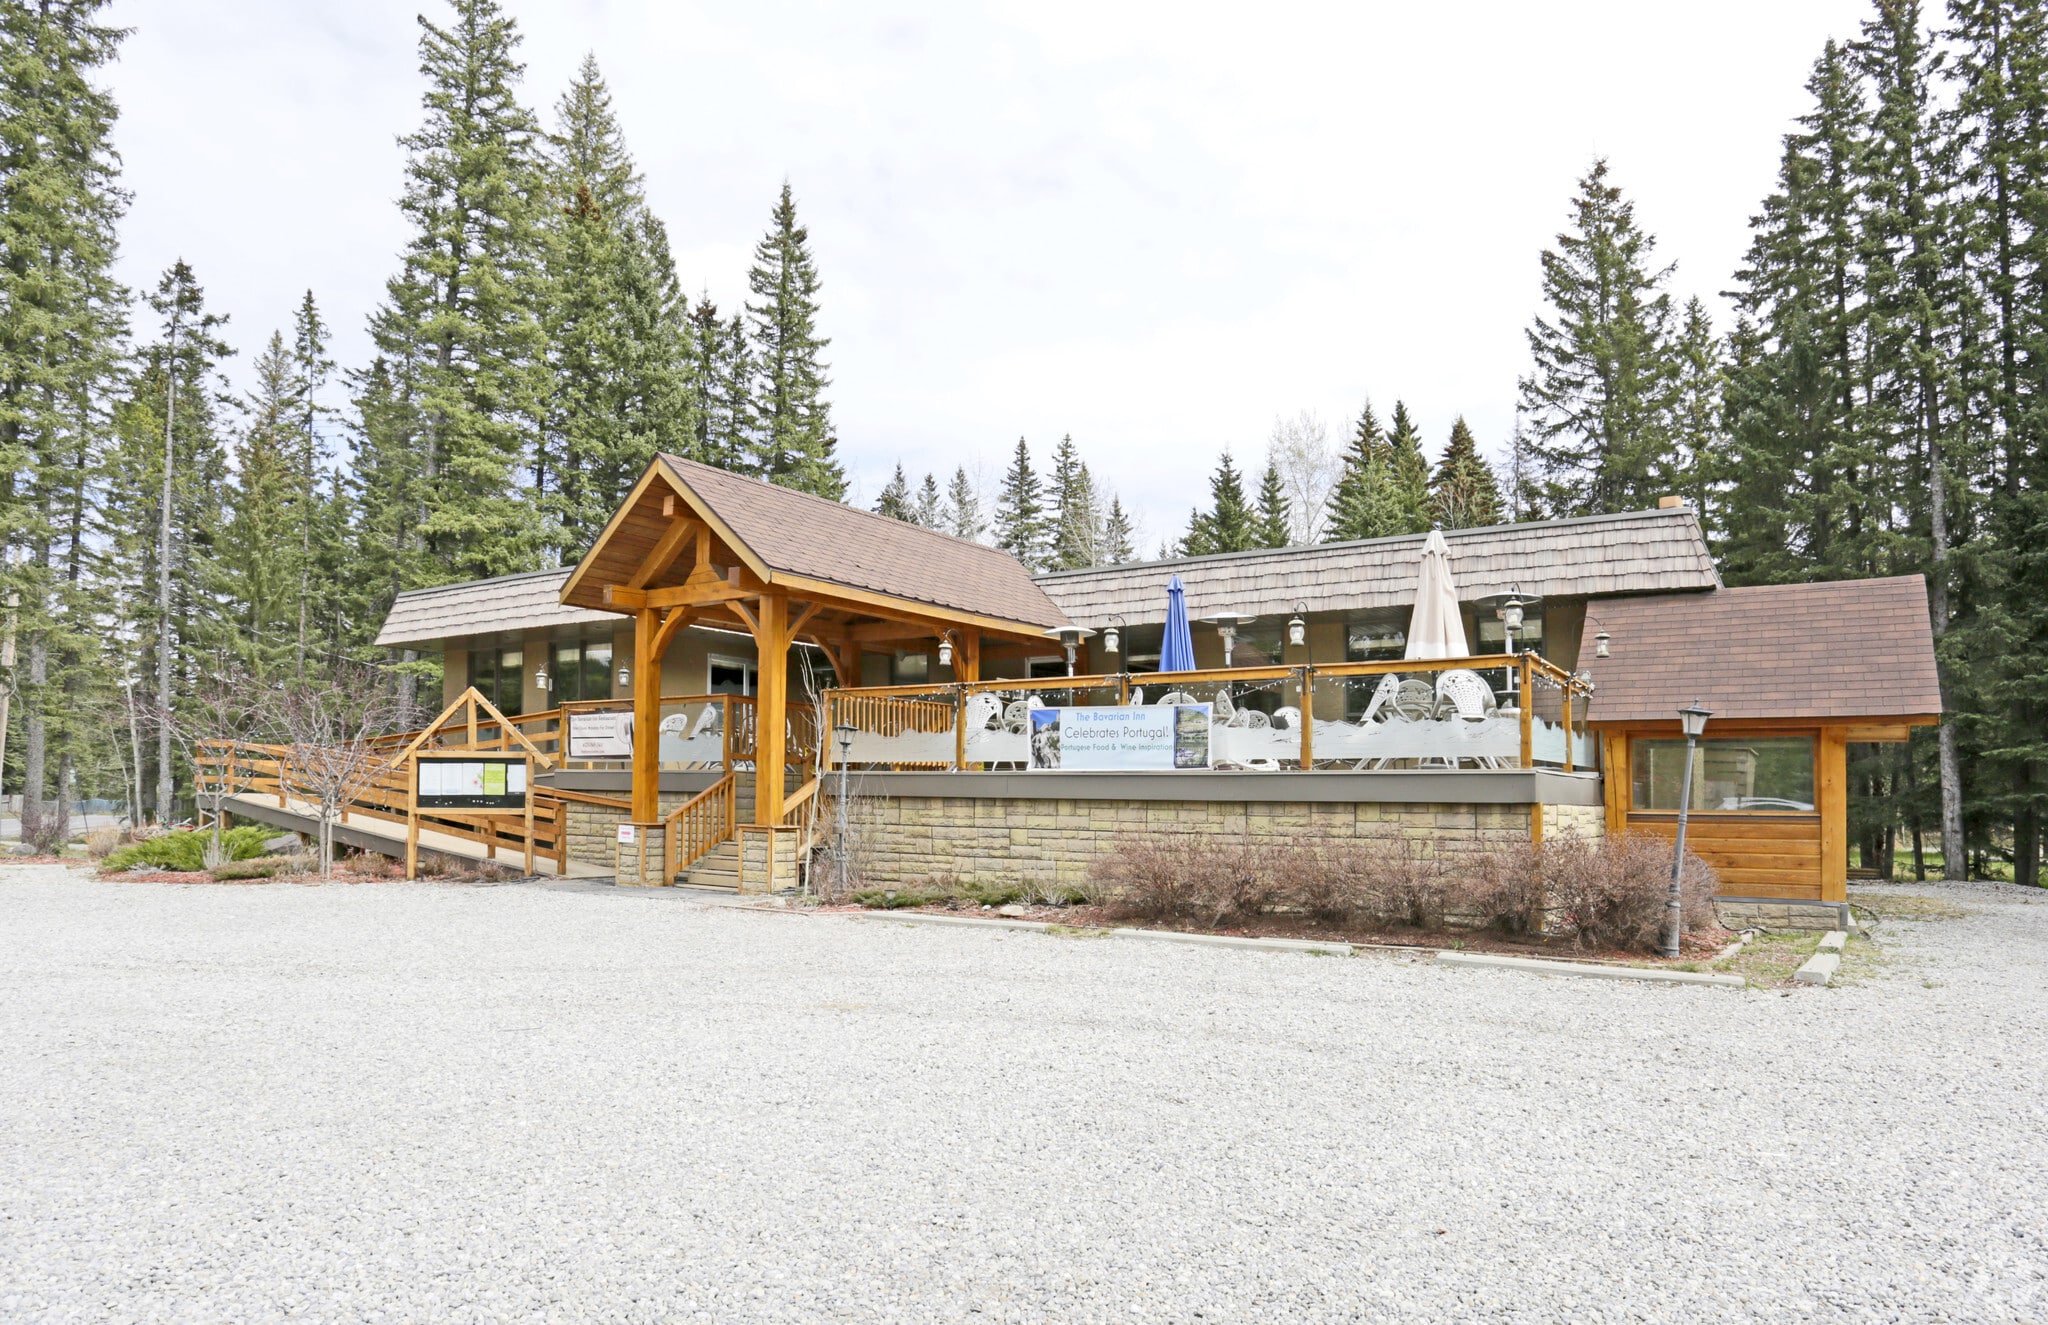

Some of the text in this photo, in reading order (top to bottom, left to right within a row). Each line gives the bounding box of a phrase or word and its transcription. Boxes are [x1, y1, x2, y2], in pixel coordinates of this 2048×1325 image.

[1076, 711, 1146, 721] The Bavarian Inn
[1064, 725, 1169, 741] Celebrates Portugal!
[1093, 743, 1109, 751] Food
[1120, 743, 1137, 751] Wine
[1138, 743, 1173, 752] Inspiration
